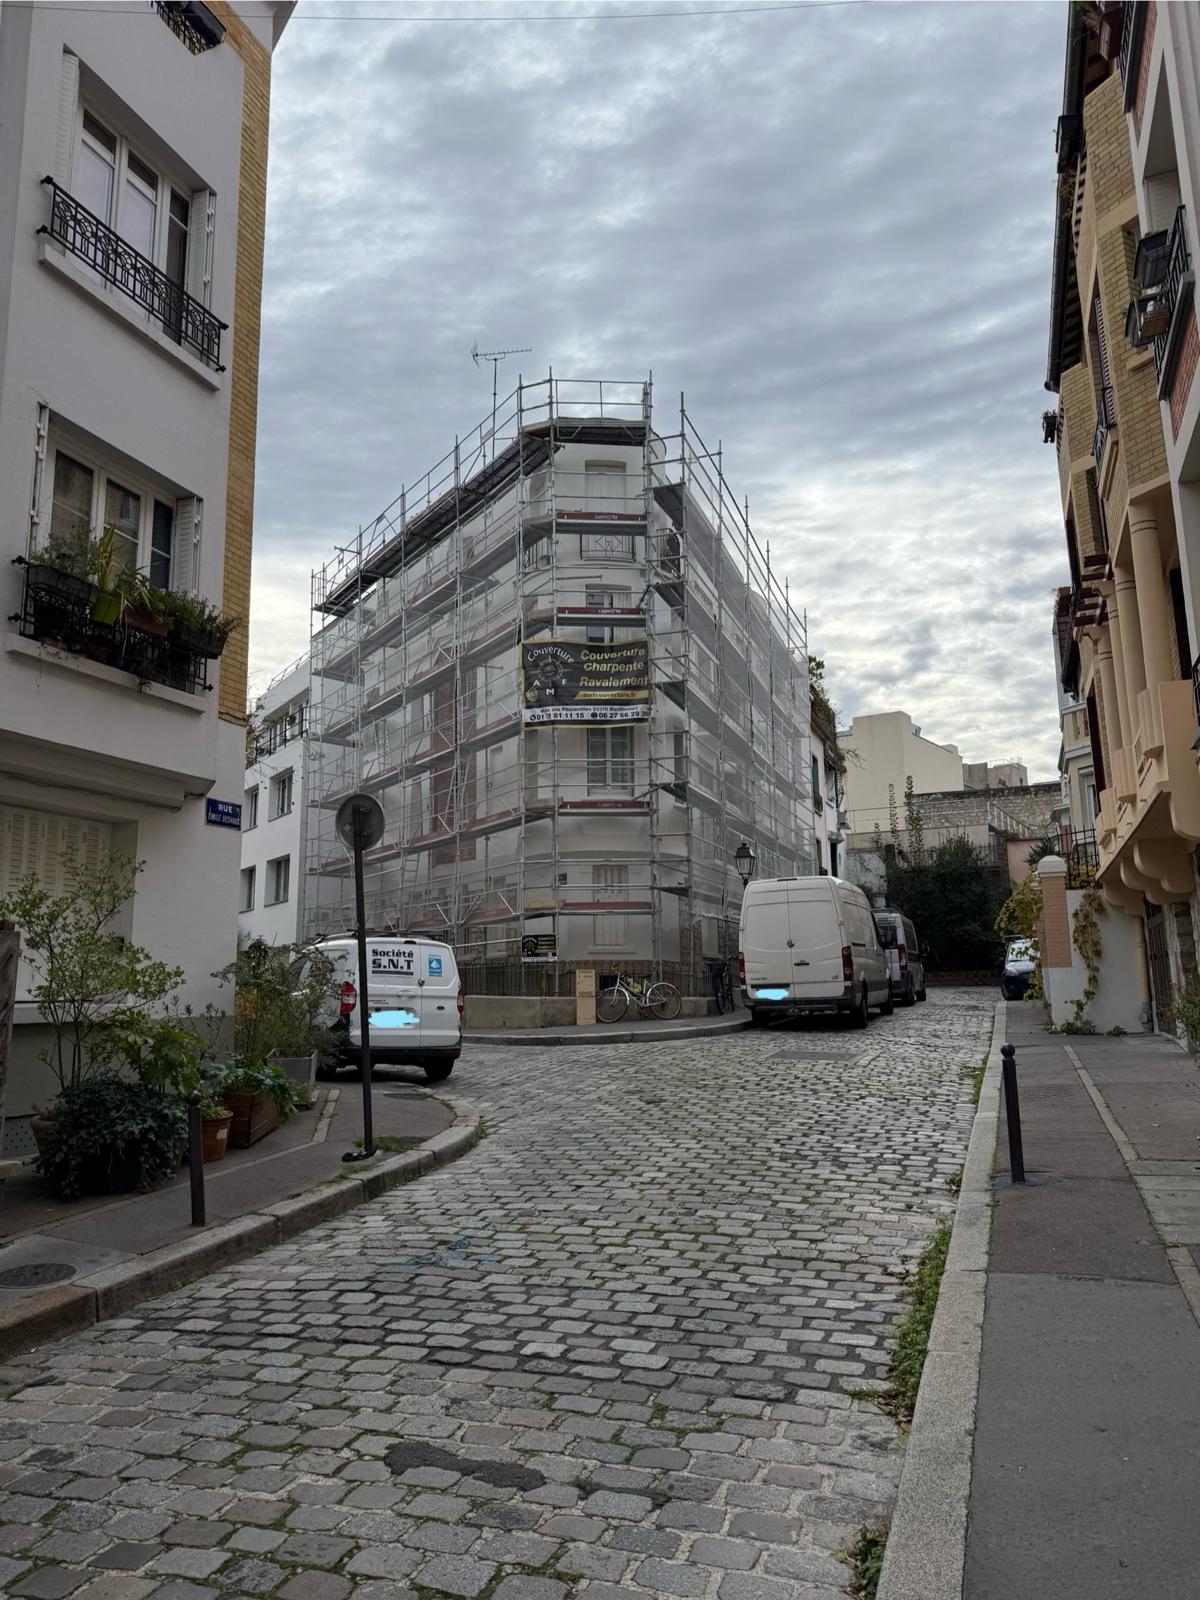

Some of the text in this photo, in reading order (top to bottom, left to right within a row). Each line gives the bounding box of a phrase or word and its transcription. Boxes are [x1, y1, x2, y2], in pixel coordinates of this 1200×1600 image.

[527, 645, 575, 664] Couverture
[580, 648, 645, 661] Couverture
[583, 661, 644, 674] Charpente
[579, 675, 649, 687] Ravalement
[218, 804, 233, 813] RUE
[372, 948, 414, 958] Société
[372, 958, 414, 970] S.N.T
